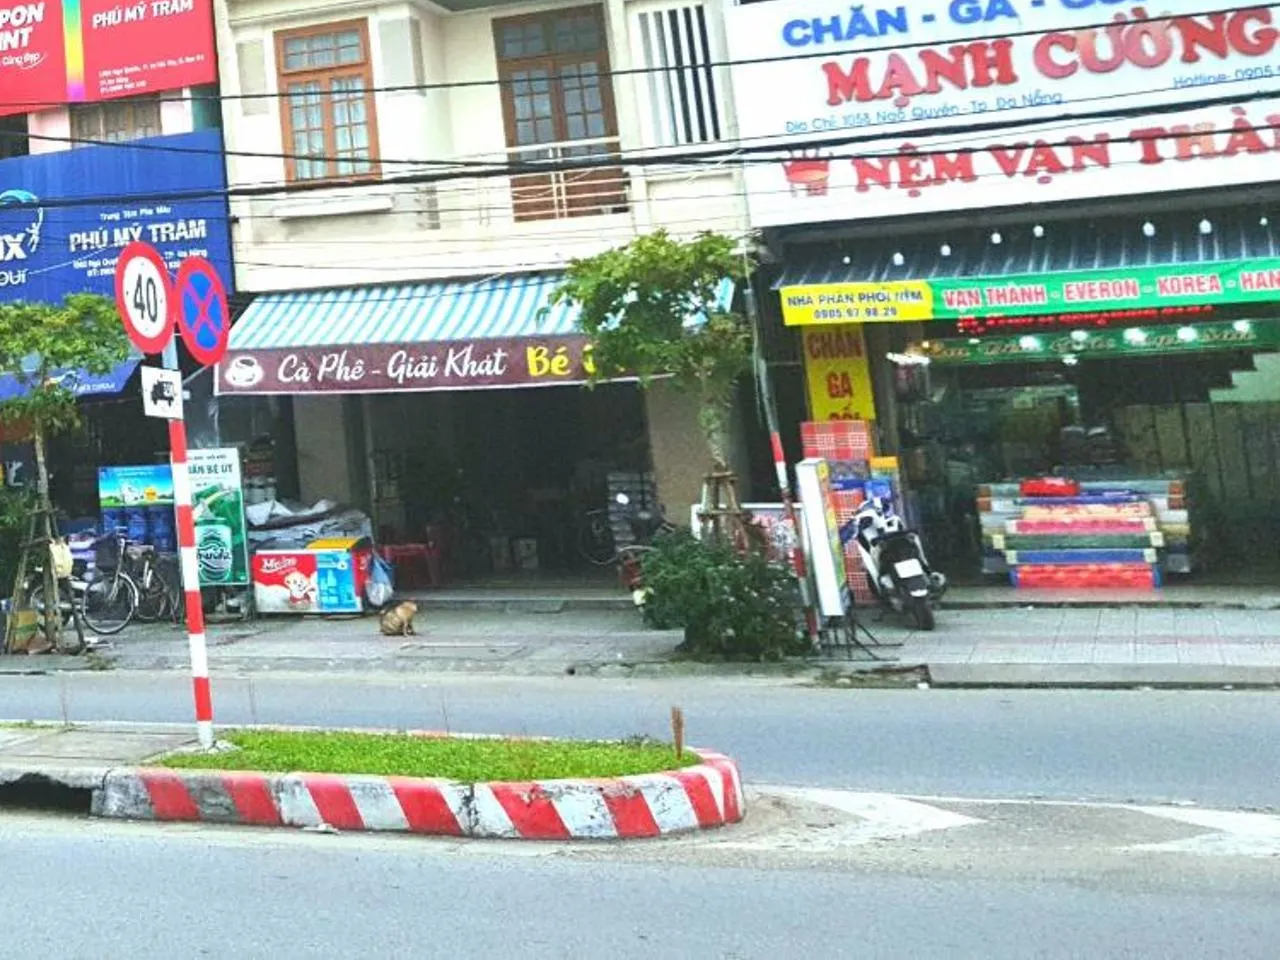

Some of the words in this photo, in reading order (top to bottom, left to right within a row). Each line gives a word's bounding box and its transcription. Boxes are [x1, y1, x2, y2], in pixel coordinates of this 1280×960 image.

[91, 5, 122, 29] PHÚ
[782, 5, 909, 49] CHĂN
[821, 37, 1019, 109] MẠNH
[1033, 6, 1280, 80] CƯỜNG
[851, 141, 979, 198] NỆM
[989, 131, 1111, 185] VẠN
[1128, 106, 1280, 165] THÀ
[69, 226, 109, 253] PHÚ
[133, 273, 158, 323] 40
[942, 286, 981, 312] VẠN
[985, 281, 1046, 306] THÀNH
[1064, 279, 1139, 302] EVERON
[1156, 274, 1222, 297] KOREA
[277, 353, 311, 383] Cà
[317, 349, 365, 382] Phê
[386, 348, 438, 381] Giải
[444, 344, 508, 379] Khát
[525, 345, 572, 376] Bé
[826, 371, 854, 400] GA
